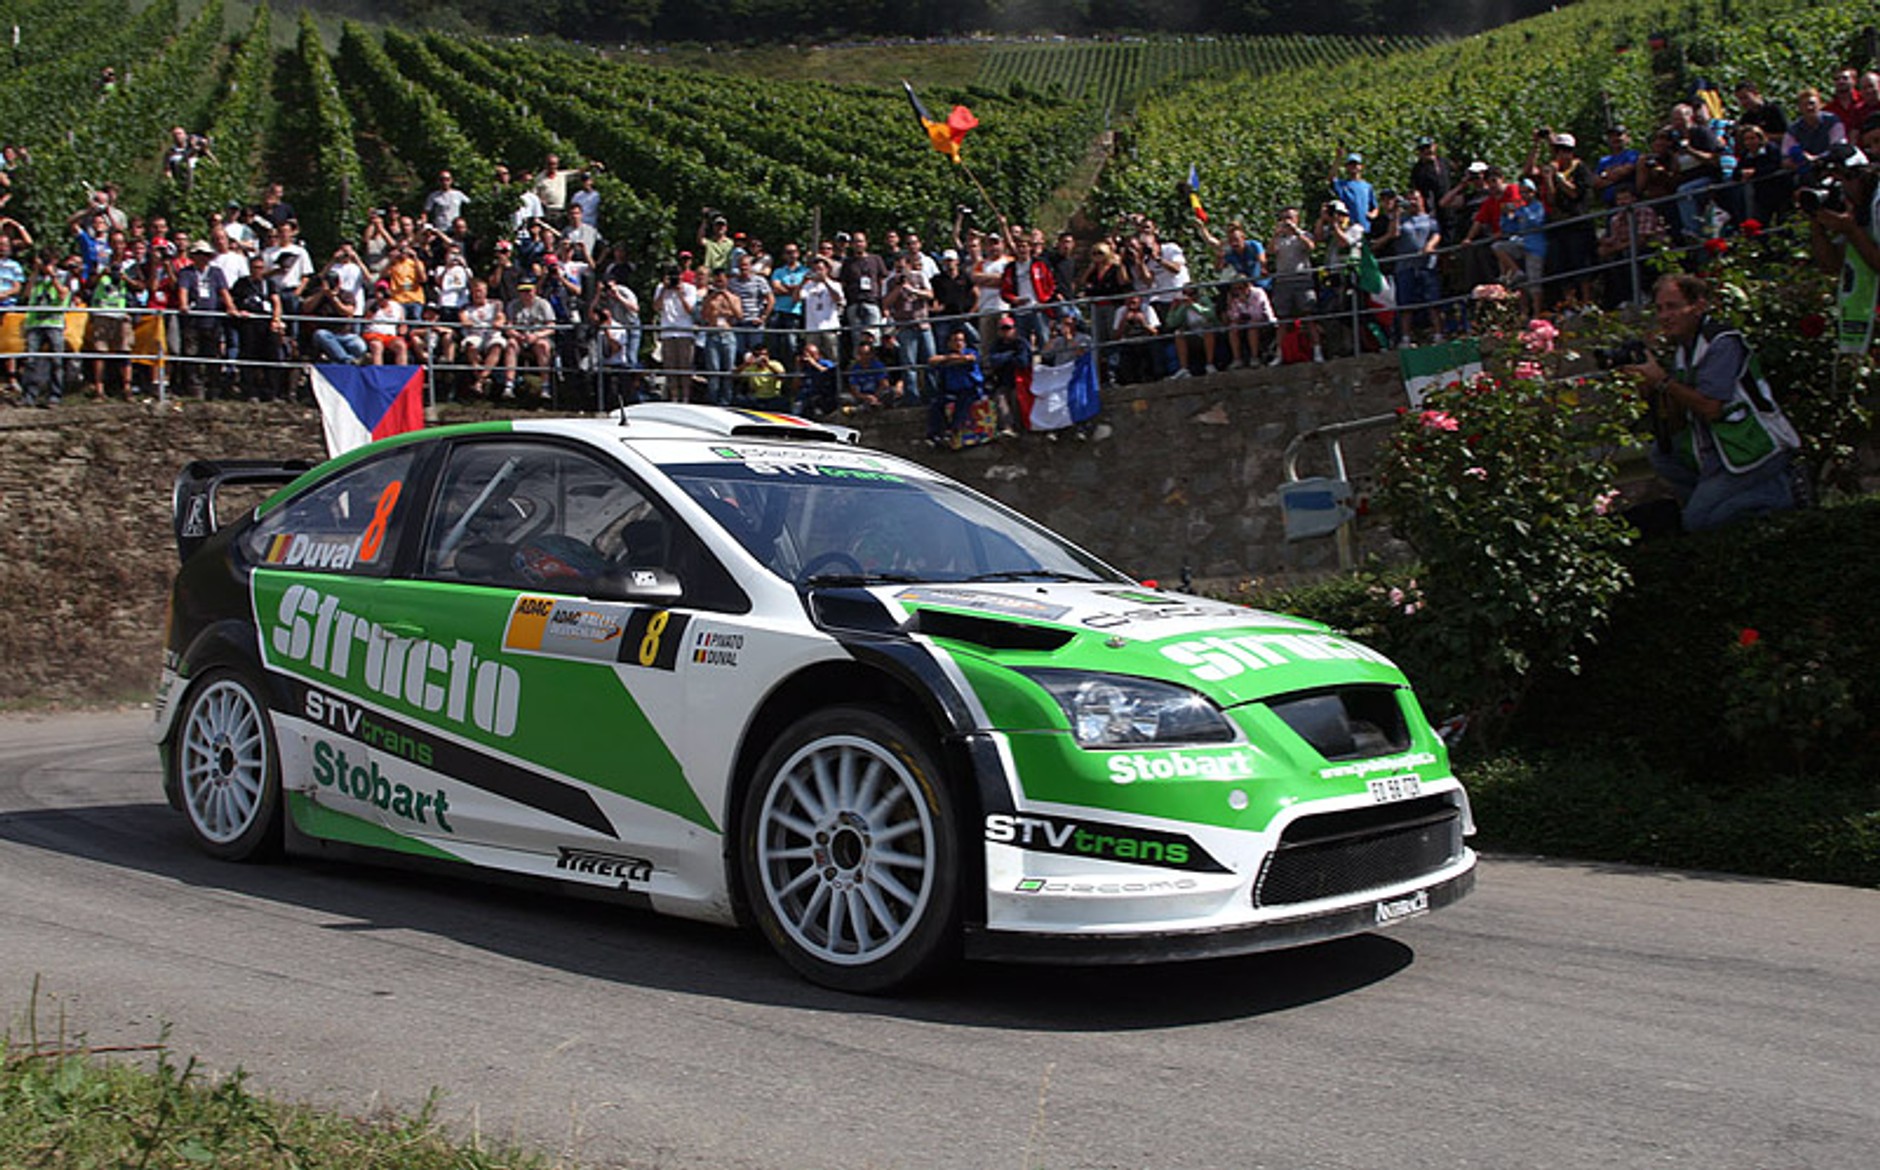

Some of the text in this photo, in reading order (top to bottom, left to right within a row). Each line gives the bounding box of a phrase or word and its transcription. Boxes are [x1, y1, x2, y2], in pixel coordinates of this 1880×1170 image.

[359, 480, 402, 561] 8
[287, 533, 363, 570] Duval
[517, 598, 551, 617] ADAC
[272, 584, 521, 738] Structo
[638, 609, 669, 668] 8
[305, 689, 434, 762] STVtrans
[312, 739, 454, 834] Stobart
[1107, 751, 1254, 784] Stobart
[556, 846, 655, 883] PIRELLI
[984, 814, 1190, 864] STVtrans
